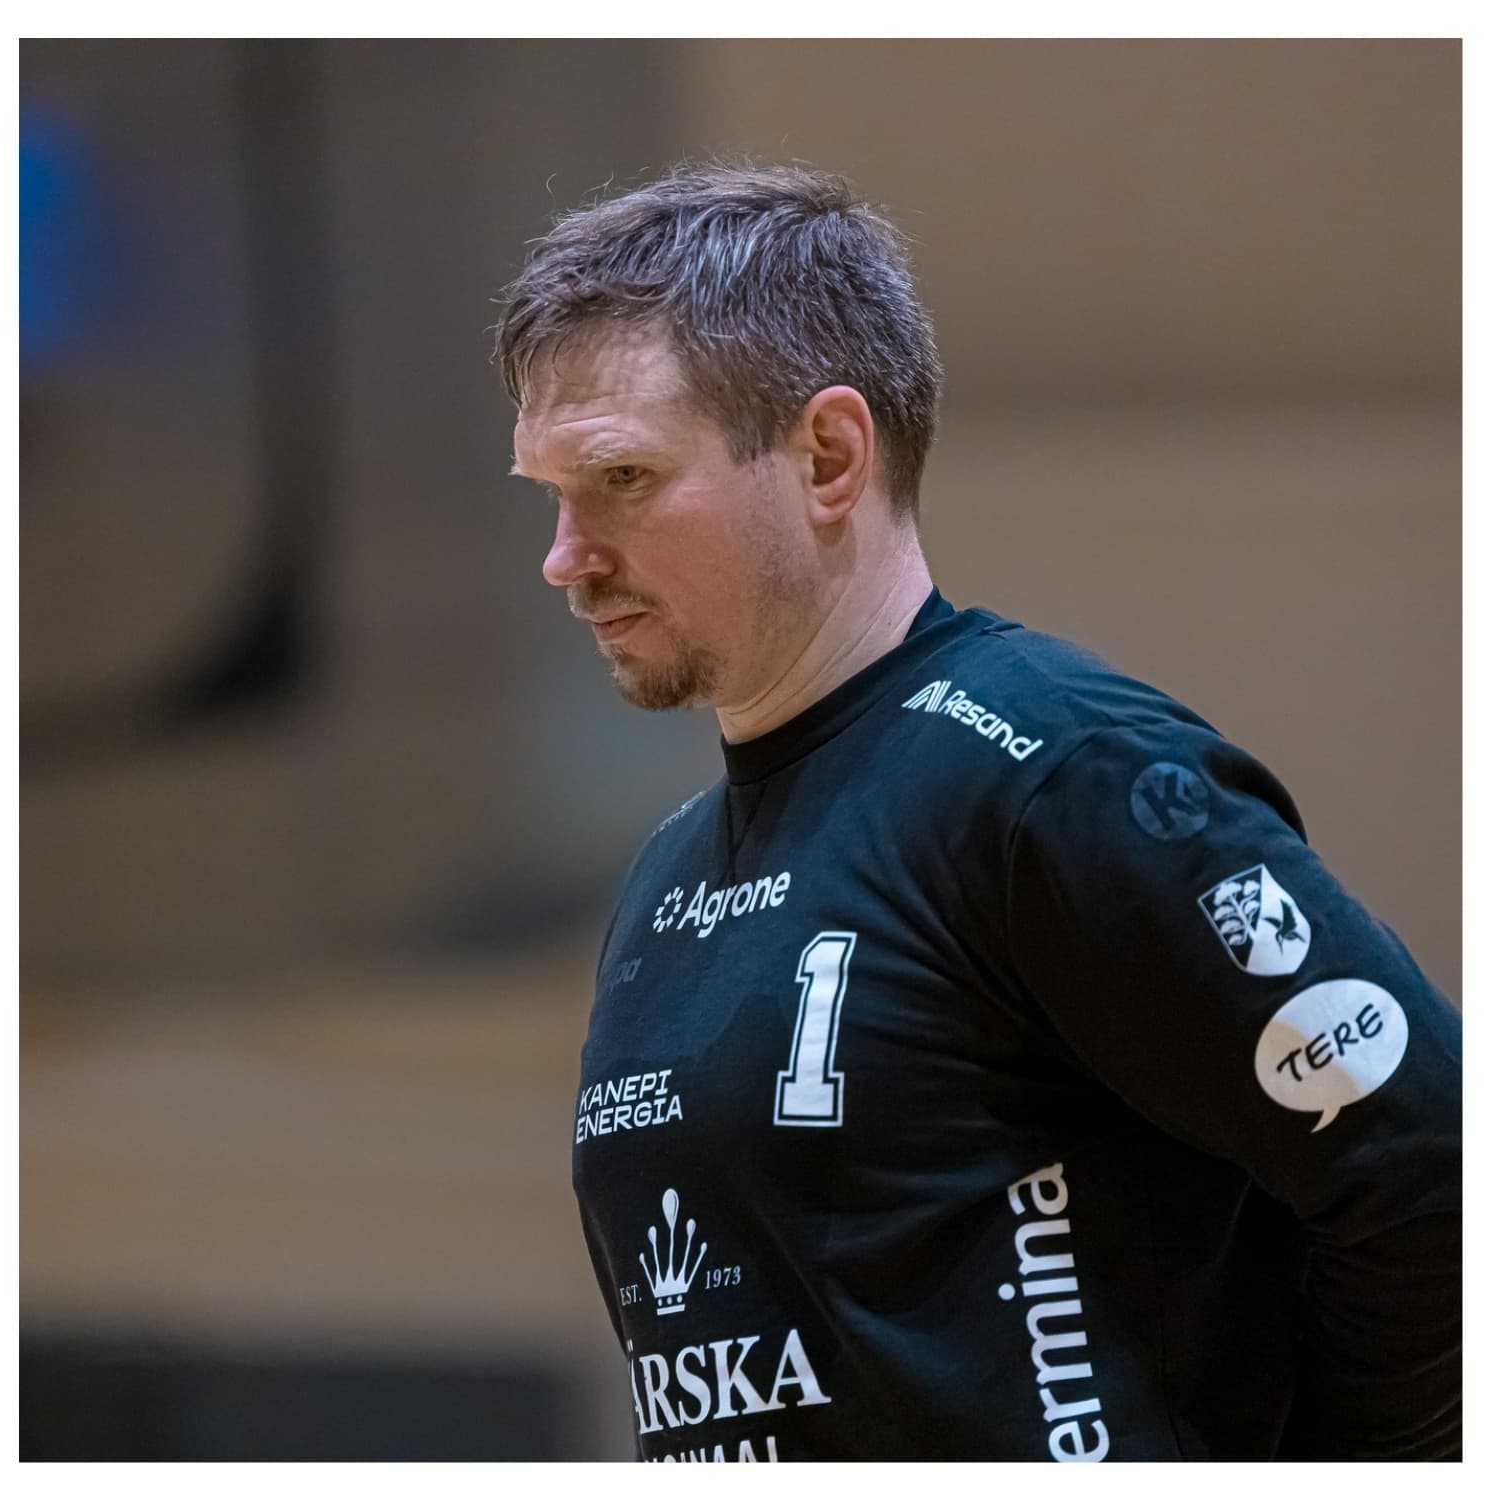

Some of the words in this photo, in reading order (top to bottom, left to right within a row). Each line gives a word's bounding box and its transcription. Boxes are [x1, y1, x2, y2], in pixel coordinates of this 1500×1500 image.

[941, 689, 1044, 763] Resand
[677, 871, 791, 939] Agrone
[773, 931, 857, 1127] 1
[1276, 1003, 1384, 1082] TERE
[576, 1095, 683, 1144] ENERGIA
[581, 1069, 672, 1114] KANEPI
[620, 1284, 642, 1306] EST.
[704, 1265, 741, 1290] 1973
[998, 1162, 1110, 1462] ermina
